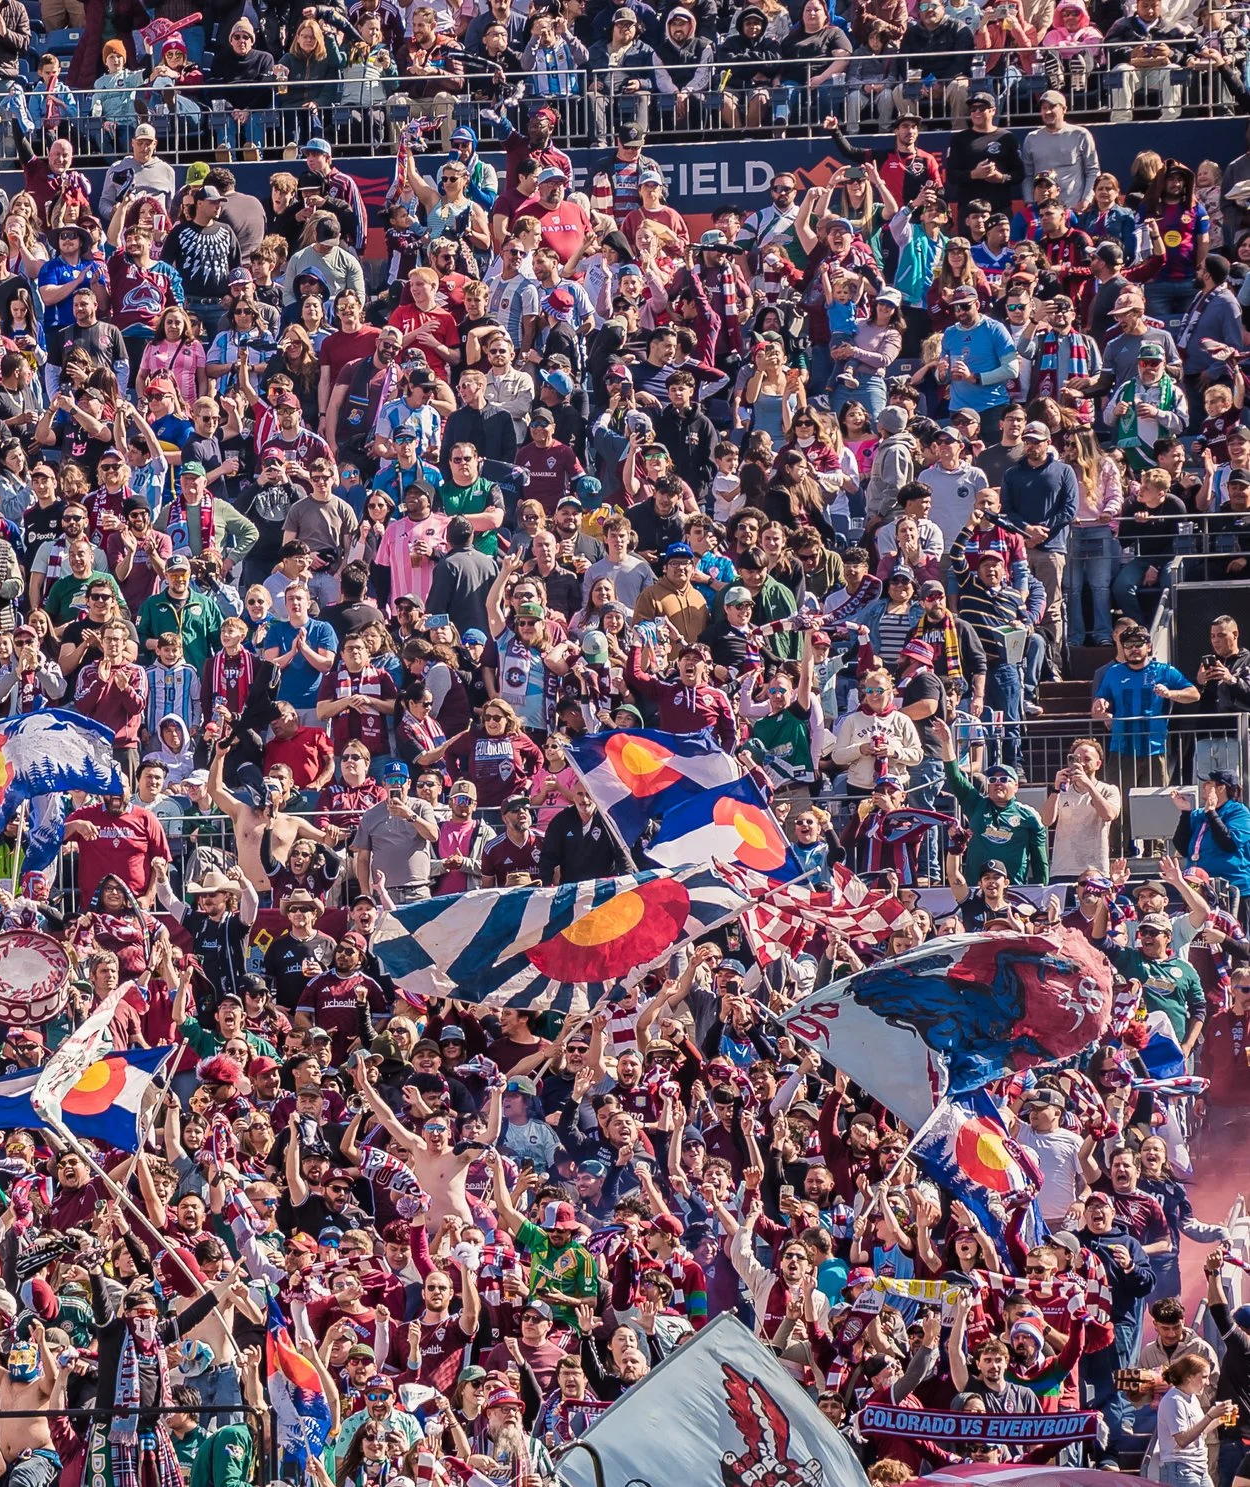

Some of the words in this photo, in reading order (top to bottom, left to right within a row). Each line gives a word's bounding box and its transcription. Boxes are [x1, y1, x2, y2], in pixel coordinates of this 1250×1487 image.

[540, 224, 577, 234] RAPIDS
[132, 473, 146, 488] 10
[36, 532, 57, 541] Spotify
[818, 667, 827, 677] C
[474, 740, 514, 757] COLORADO
[322, 998, 357, 1009] uchealth
[529, 1135, 538, 1144] C
[862, 1408, 956, 1437] COLORADO
[959, 1418, 983, 1436] VS
[986, 1415, 1091, 1438] EVERYBODY
